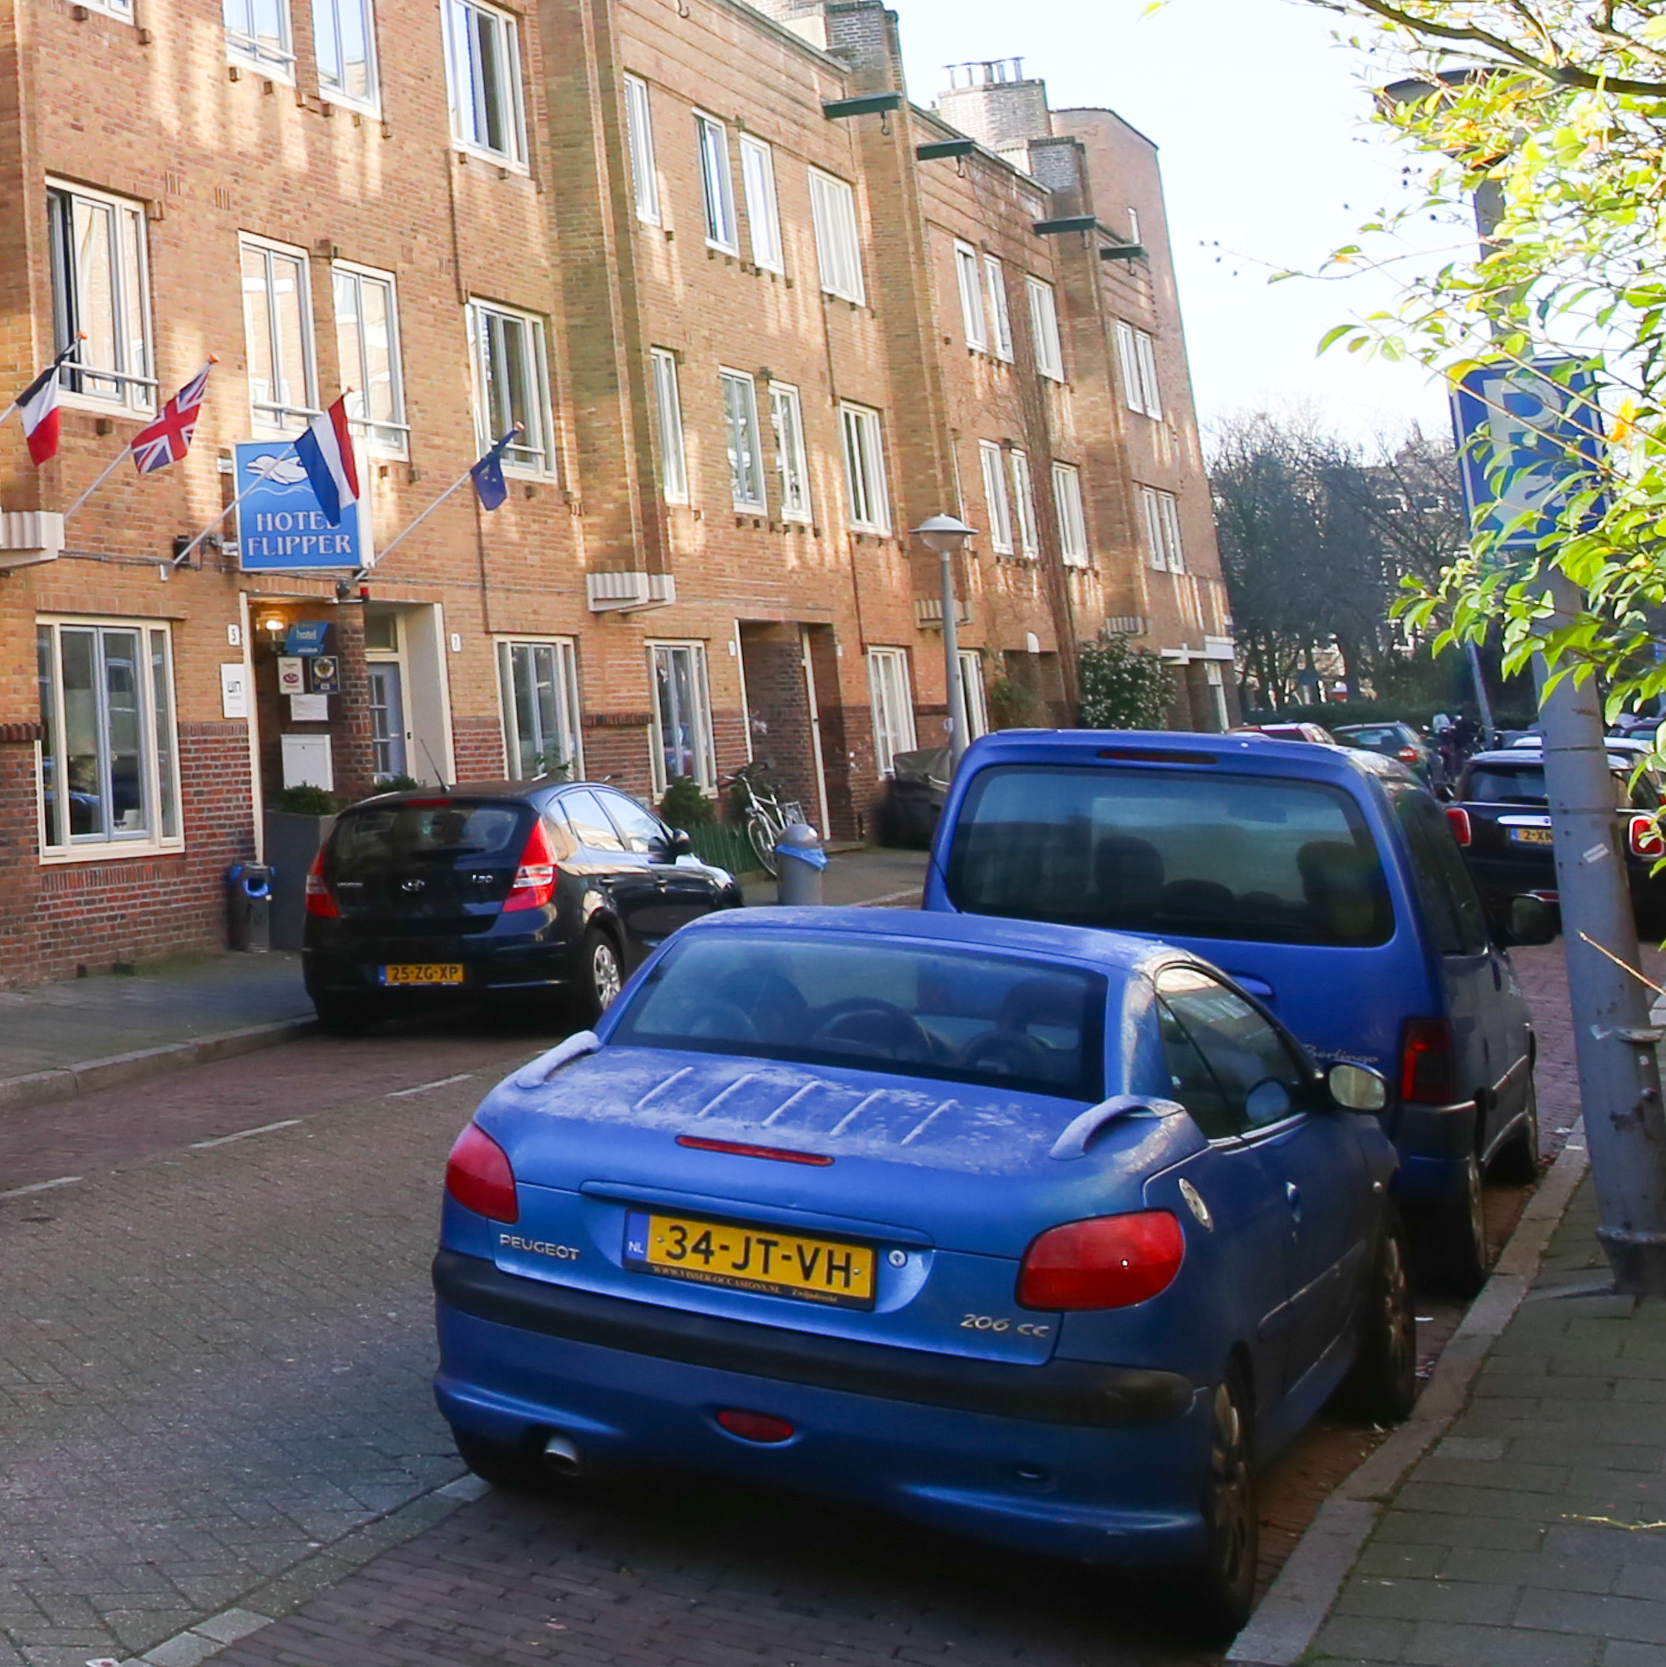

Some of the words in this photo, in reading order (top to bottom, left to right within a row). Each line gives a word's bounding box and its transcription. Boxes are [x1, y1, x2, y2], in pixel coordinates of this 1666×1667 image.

[247, 534, 353, 557] FLIPPER
[392, 965, 459, 981] 25-ZG-XP
[499, 1233, 580, 1261] PEUGEOT
[628, 1241, 644, 1254] NL
[665, 1225, 852, 1288] 34-JT-VH
[960, 1313, 1011, 1332] 206
